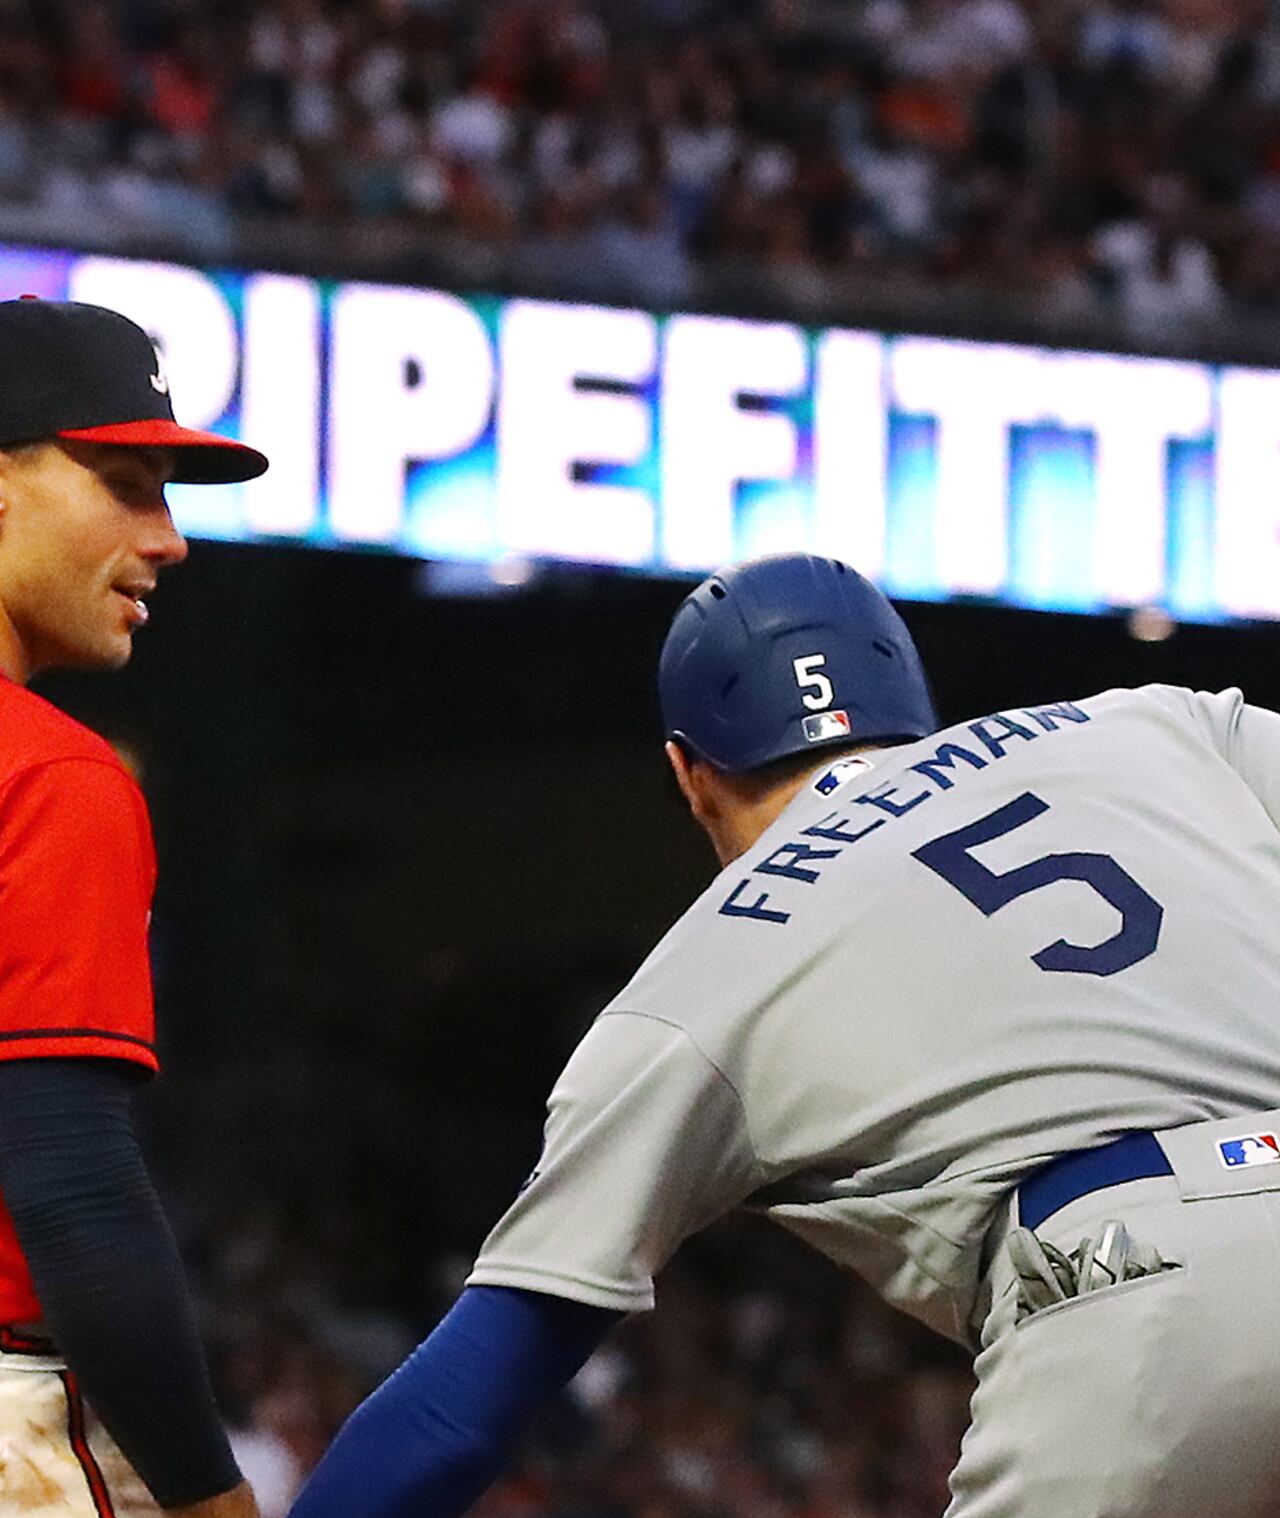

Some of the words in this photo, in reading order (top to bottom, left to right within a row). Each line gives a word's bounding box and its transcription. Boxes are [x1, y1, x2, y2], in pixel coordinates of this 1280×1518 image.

[793, 653, 834, 711] 5
[718, 700, 1090, 925] FREEMAN
[910, 791, 1164, 977] 5
